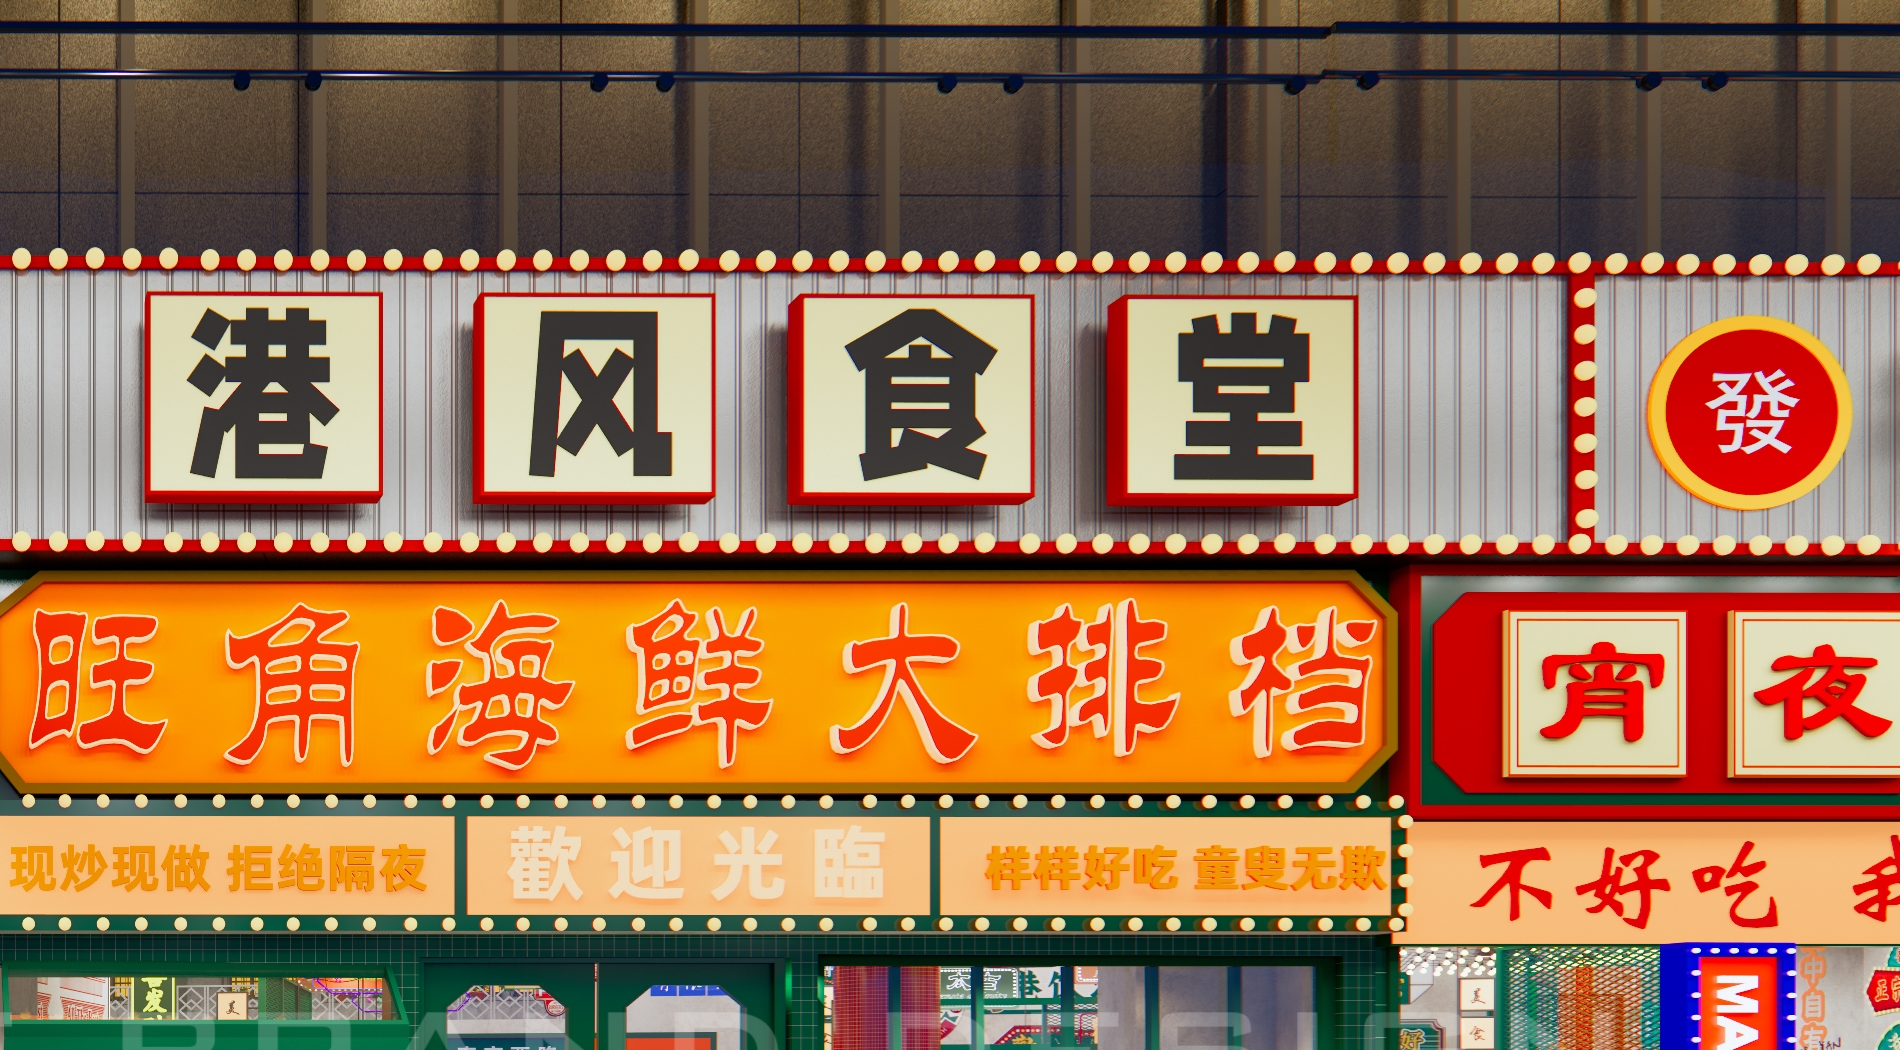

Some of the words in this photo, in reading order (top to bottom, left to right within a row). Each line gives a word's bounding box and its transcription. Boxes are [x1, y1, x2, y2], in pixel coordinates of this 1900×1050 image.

[186, 307, 1314, 481] 港风食堂
[1705, 368, 1800, 454] 發
[28, 598, 1378, 770] 旺角海鲜大排档
[1540, 642, 1893, 742] 宵夜
[9, 843, 210, 893] 现炒现做
[227, 843, 427, 893] 拒绝隔夜
[506, 824, 886, 901] 歡迎光臨
[985, 844, 1179, 891] 样样好吃
[1193, 844, 1388, 891] 童叟无欺
[1471, 841, 1779, 929] 不好吃
